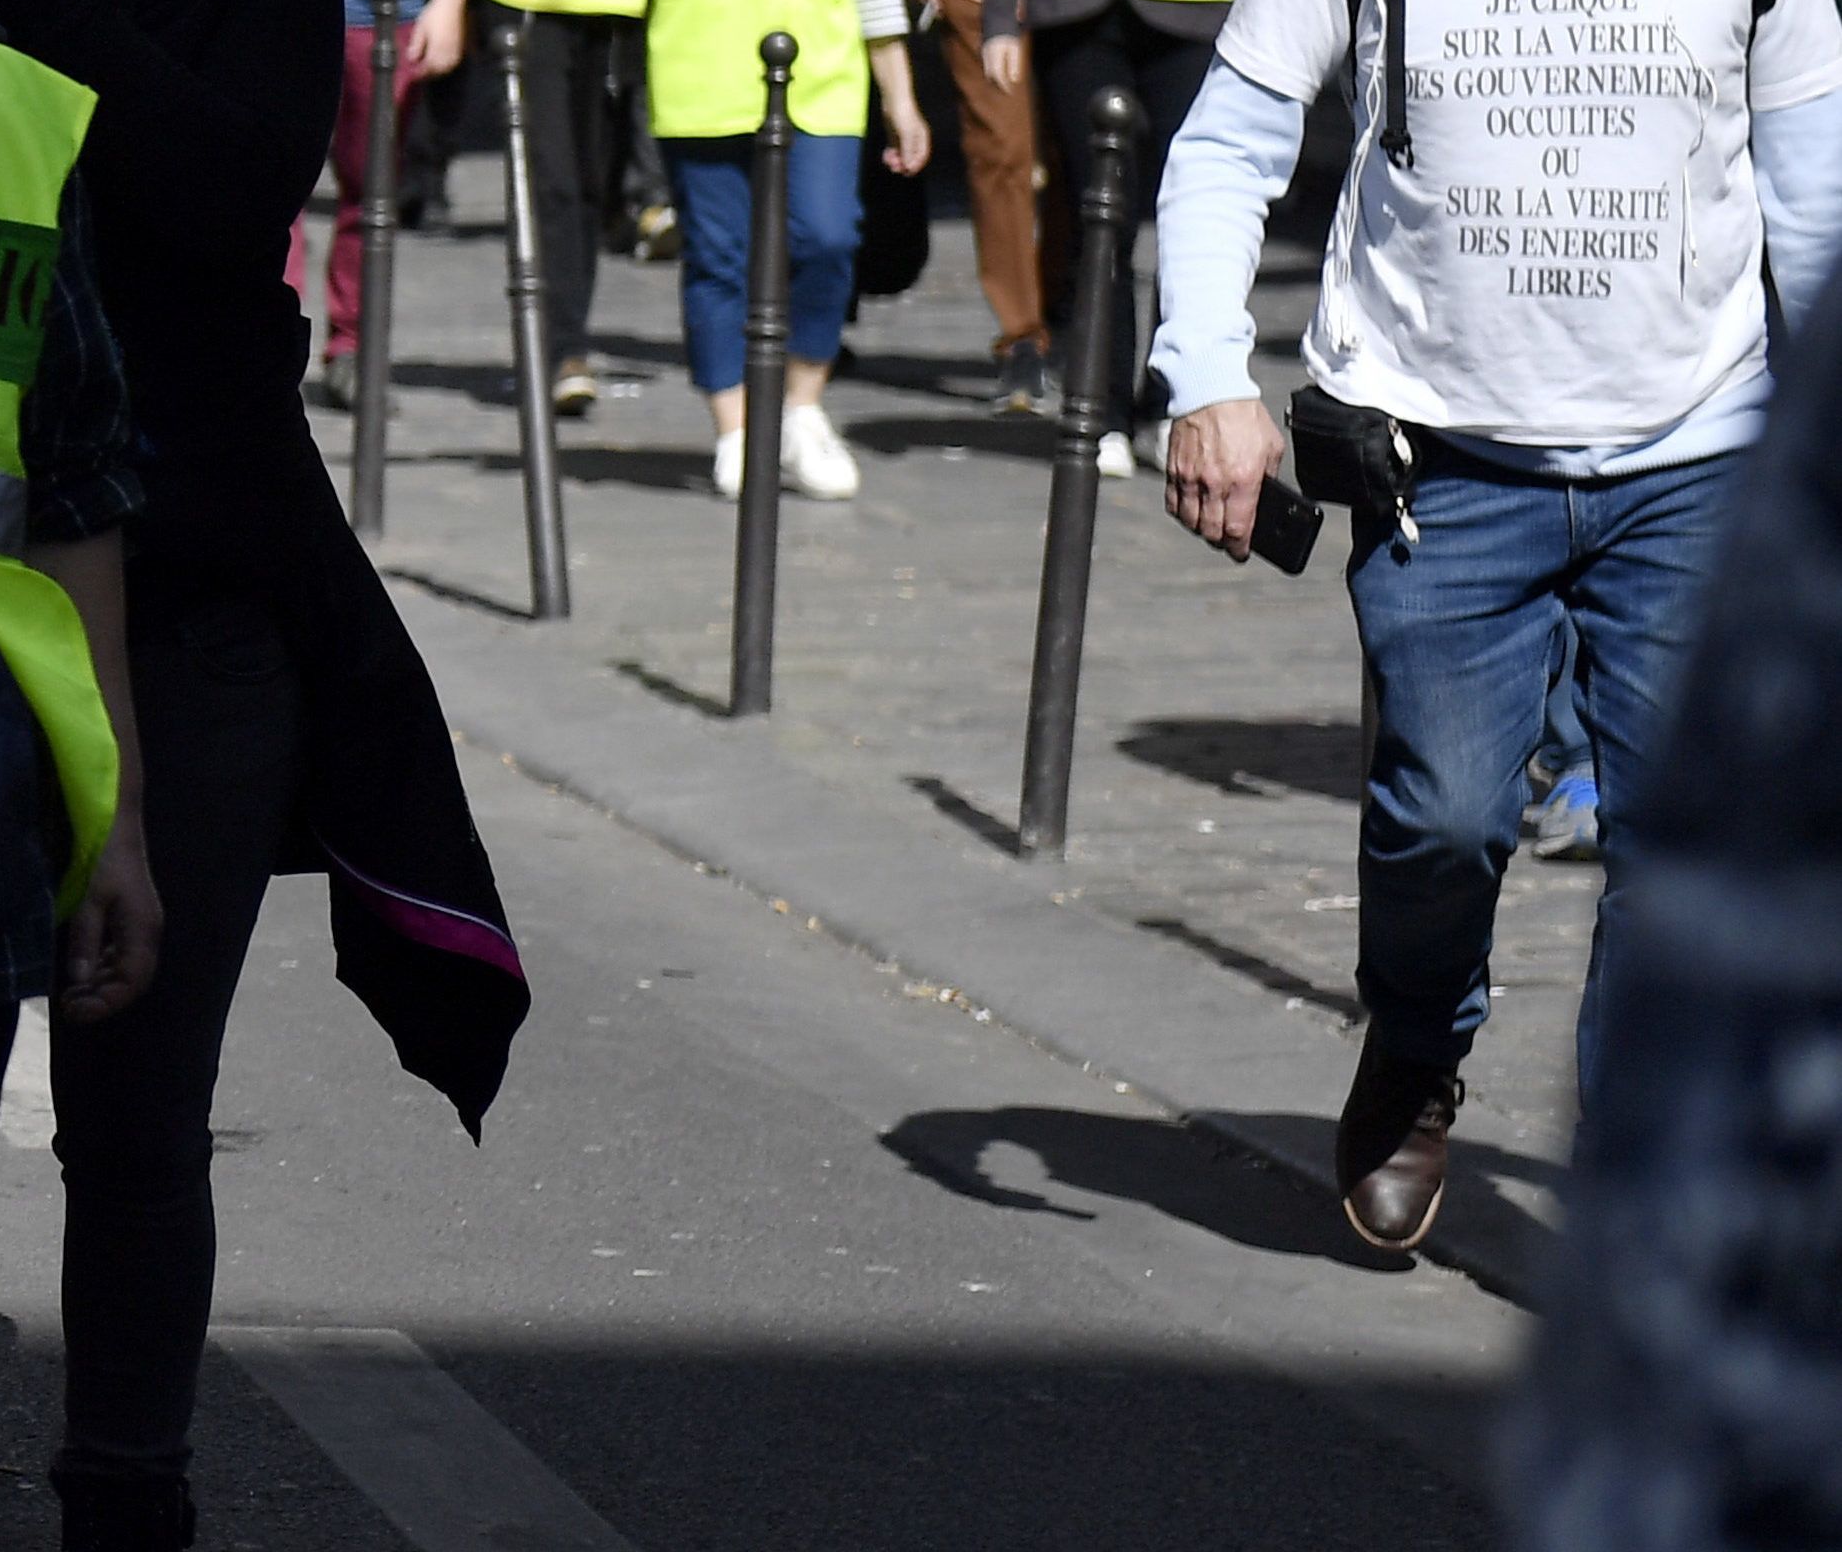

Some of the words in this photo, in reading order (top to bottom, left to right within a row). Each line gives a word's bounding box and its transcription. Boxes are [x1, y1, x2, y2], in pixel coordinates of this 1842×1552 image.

[1442, 27, 1503, 61] SUR
[1514, 24, 1554, 57] LA
[1453, 64, 1715, 100] GOUVERNEMENTS
[1485, 104, 1636, 139] OCCULTES
[1541, 146, 1582, 179] OU
[1445, 184, 1504, 218] SUR
[1515, 187, 1554, 218] LA
[1458, 225, 1511, 256] DES
[1521, 228, 1659, 262] ENERGIES
[1507, 266, 1612, 299] LIBRES
